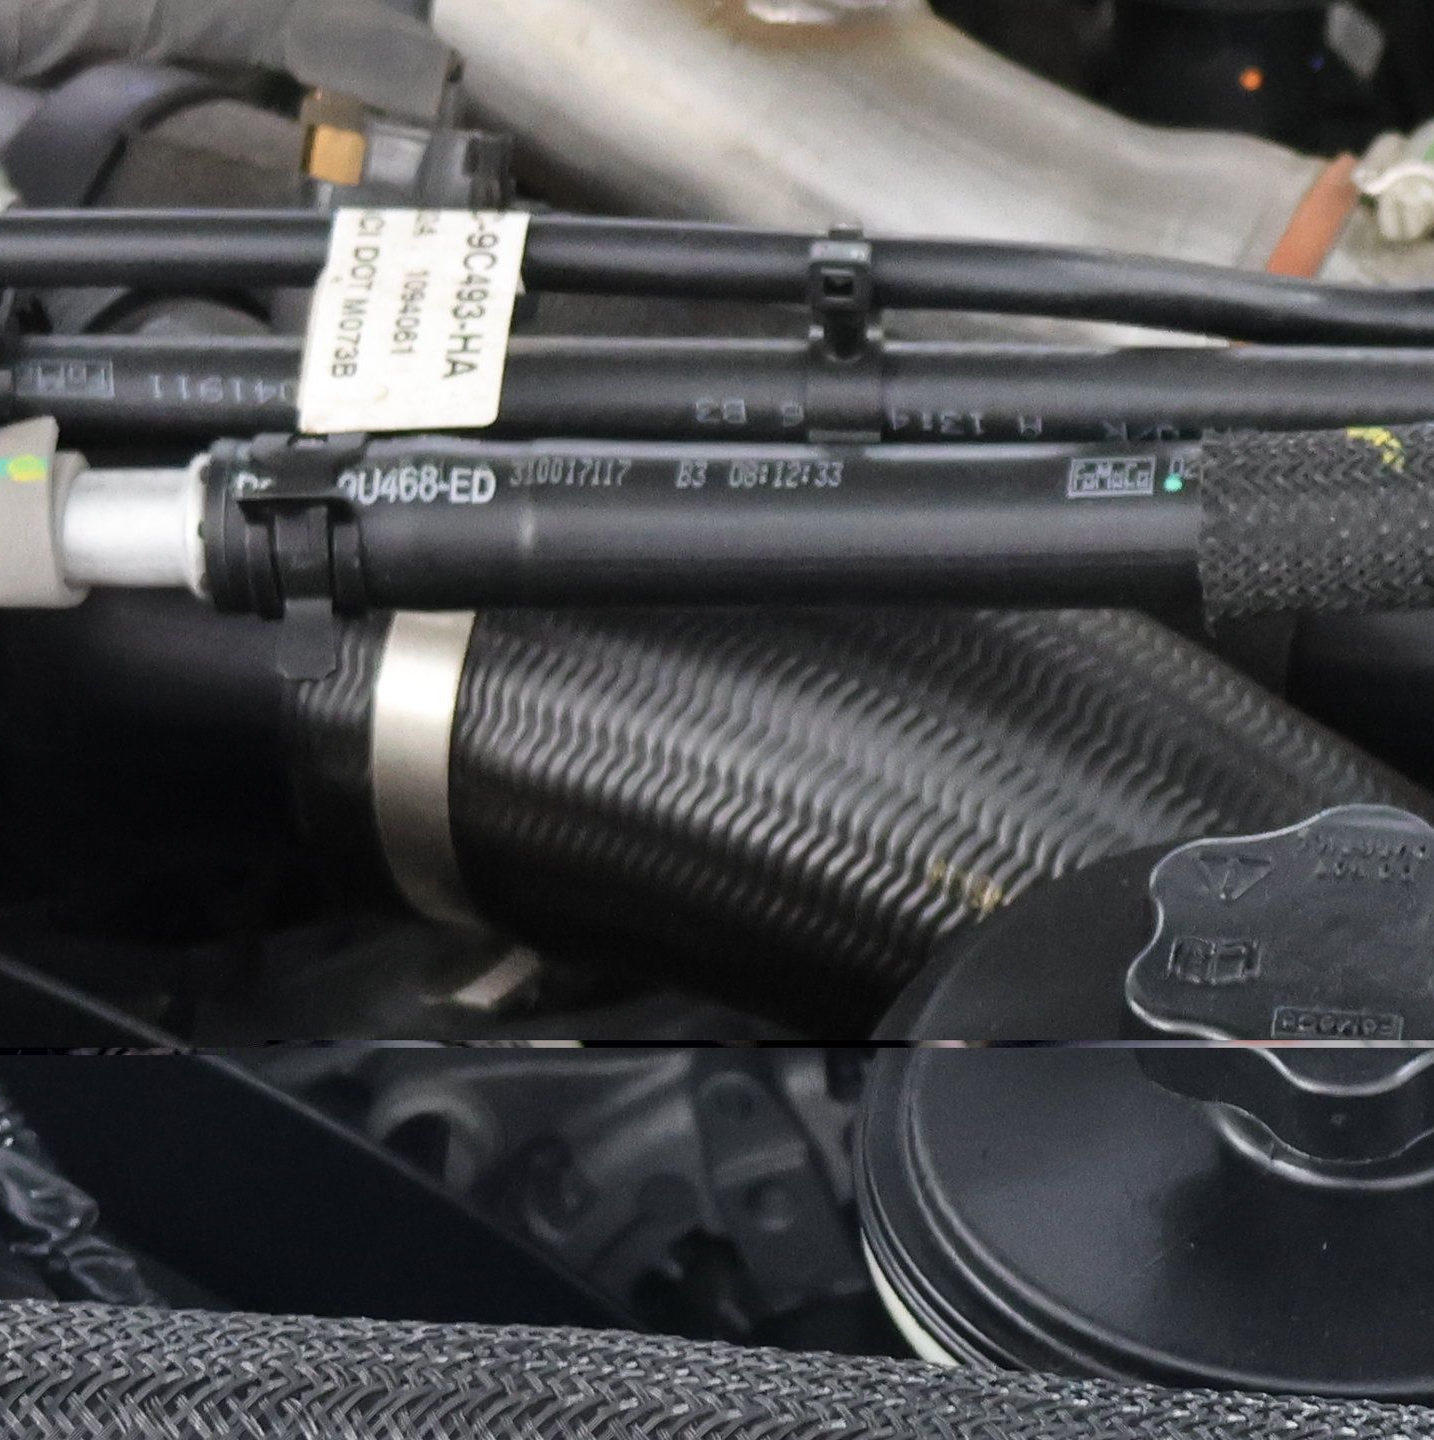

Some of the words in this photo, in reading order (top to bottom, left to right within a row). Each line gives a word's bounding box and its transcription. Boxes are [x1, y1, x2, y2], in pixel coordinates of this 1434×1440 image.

[349, 246, 380, 291] DOT
[443, 211, 500, 380] -9C493-HA
[331, 298, 369, 379] M073B
